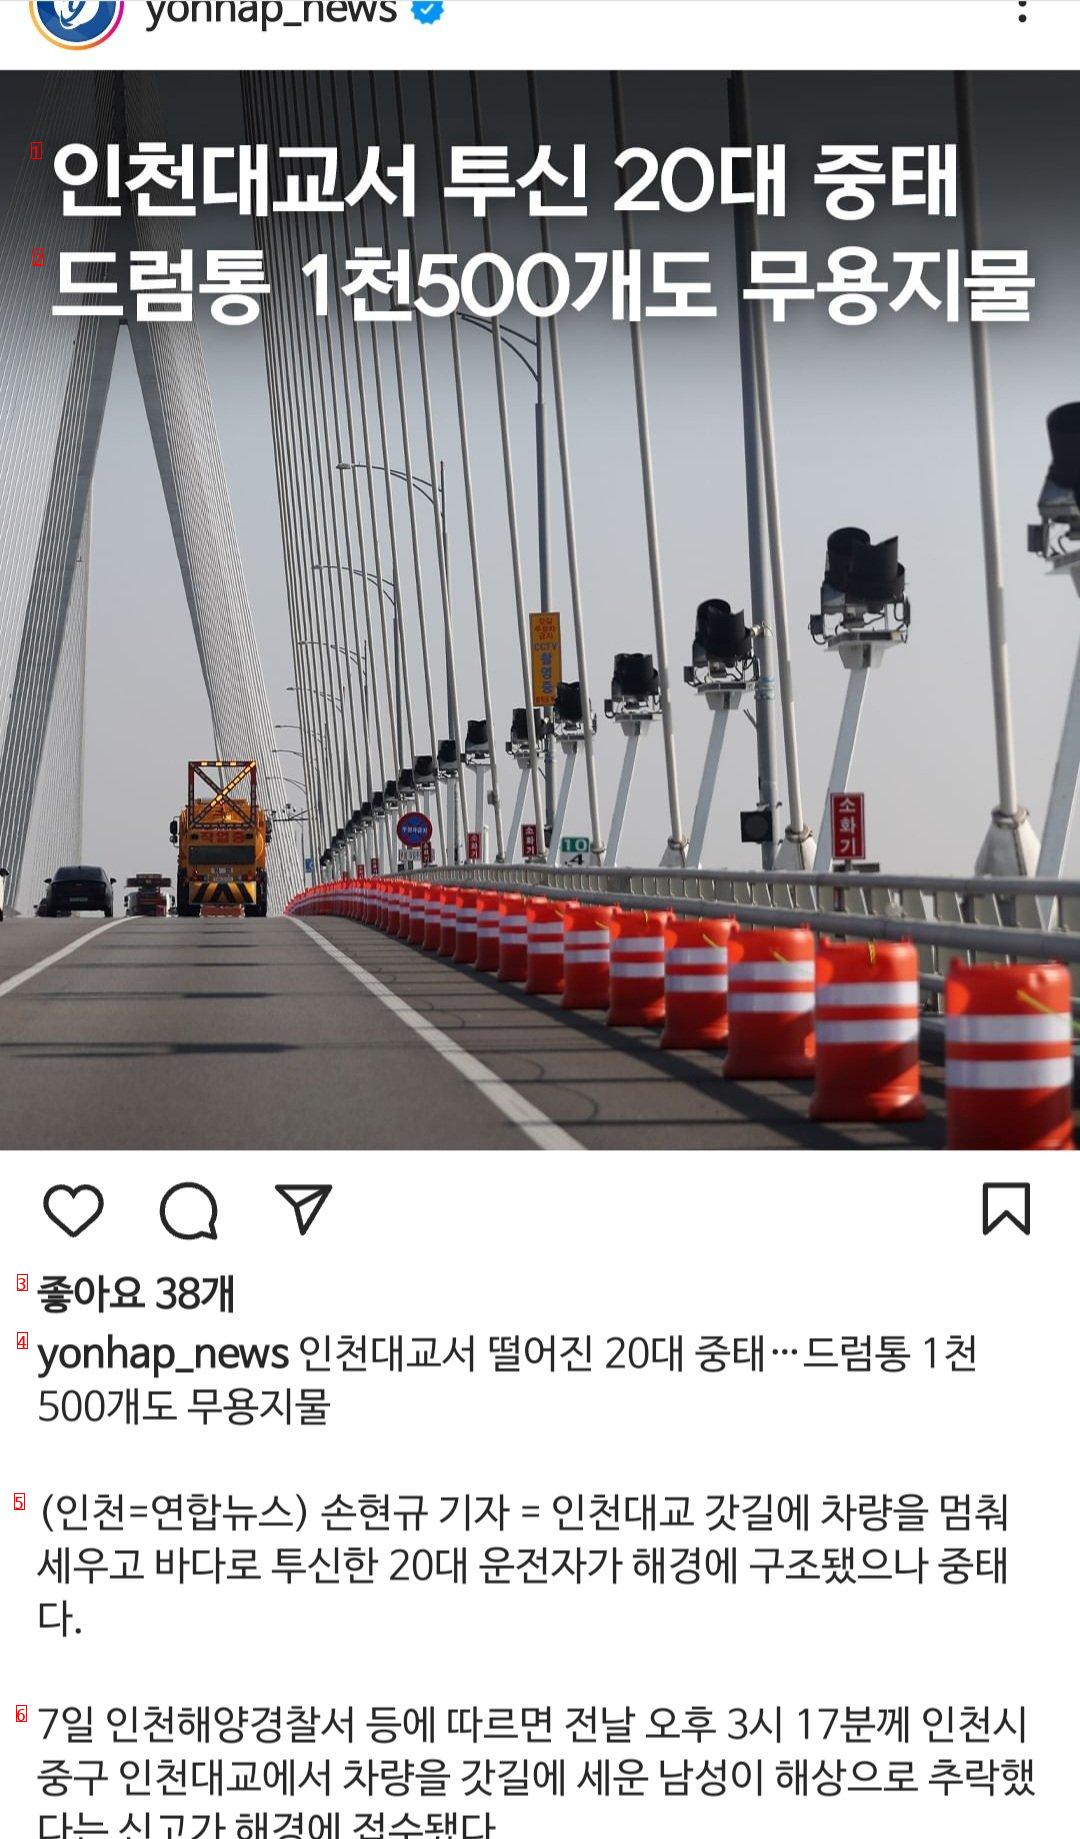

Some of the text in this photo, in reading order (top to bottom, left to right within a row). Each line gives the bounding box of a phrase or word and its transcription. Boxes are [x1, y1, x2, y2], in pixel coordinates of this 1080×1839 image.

[534, 642, 559, 652] CCTV
[563, 838, 588, 852] 10
[838, 797, 857, 856] 소화기
[37, 1274, 234, 1314] 좋아요 38개
[37, 1333, 290, 1379] yonhap_news
[299, 1334, 474, 1373] 인천대교서
[489, 1334, 592, 1373] 떨어진
[605, 1334, 683, 1373] 20대
[924, 1334, 976, 1372] 1천
[38, 1387, 331, 1426] 500개도 무용지물
[42, 1493, 1007, 1533] (인천=연합뉴스) 손현규 기자 = 인천대교 갓길에 차량을 멈춰
[37, 1546, 1007, 1585] 세우고 바다로 투신한 20대 운전자가 해경에 구조됐으나 중태
[39, 1599, 82, 1638] 다.
[38, 1705, 1025, 1744] 7일 인천해양경찰서 등에 따르면 전날 오후 3시 17분께 인천시
[37, 1758, 1036, 1797] 중구 인천대교에서 차량을 갓길에 세운 남성이 해상으로 추락했
